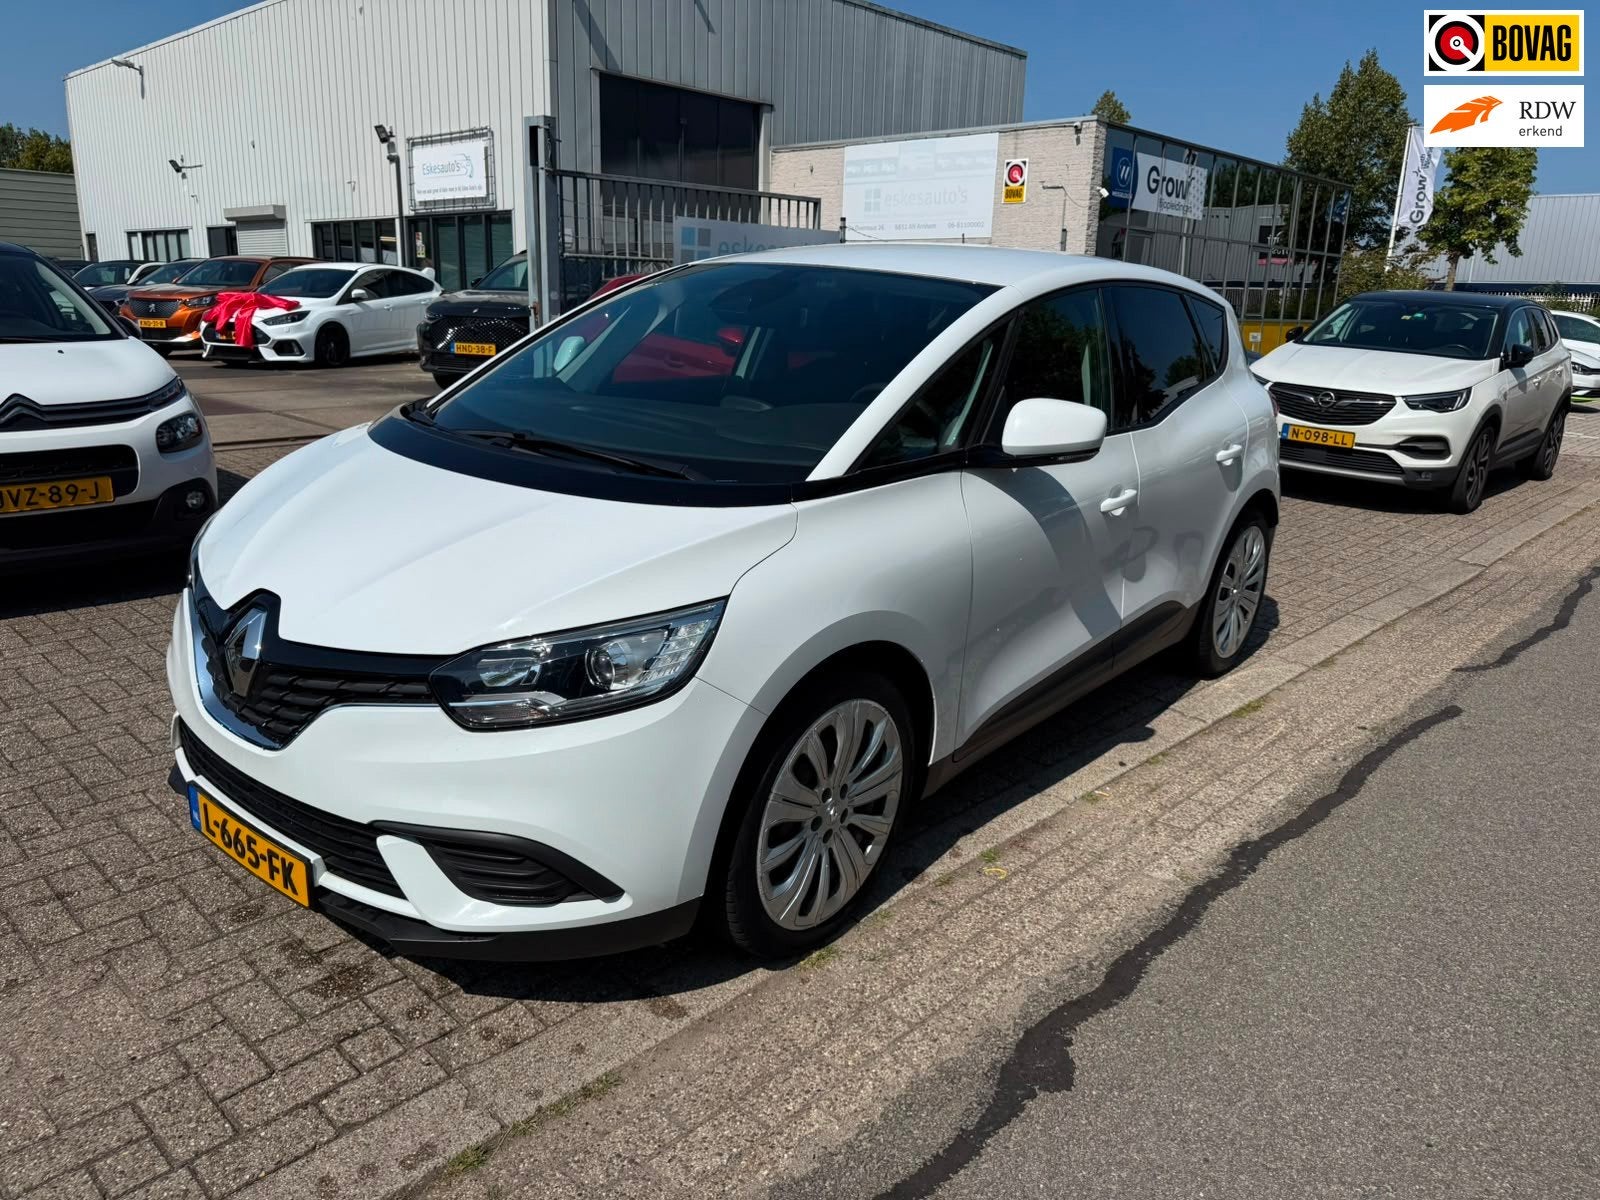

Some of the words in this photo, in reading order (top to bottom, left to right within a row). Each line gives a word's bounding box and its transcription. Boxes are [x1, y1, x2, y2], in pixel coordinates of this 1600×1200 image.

[1147, 165, 1190, 200] Grow
[1409, 174, 1427, 224] Grow
[455, 344, 494, 354] HND-38-F
[1291, 428, 1348, 446] N-098-LL
[203, 803, 299, 896] L-665-FK
